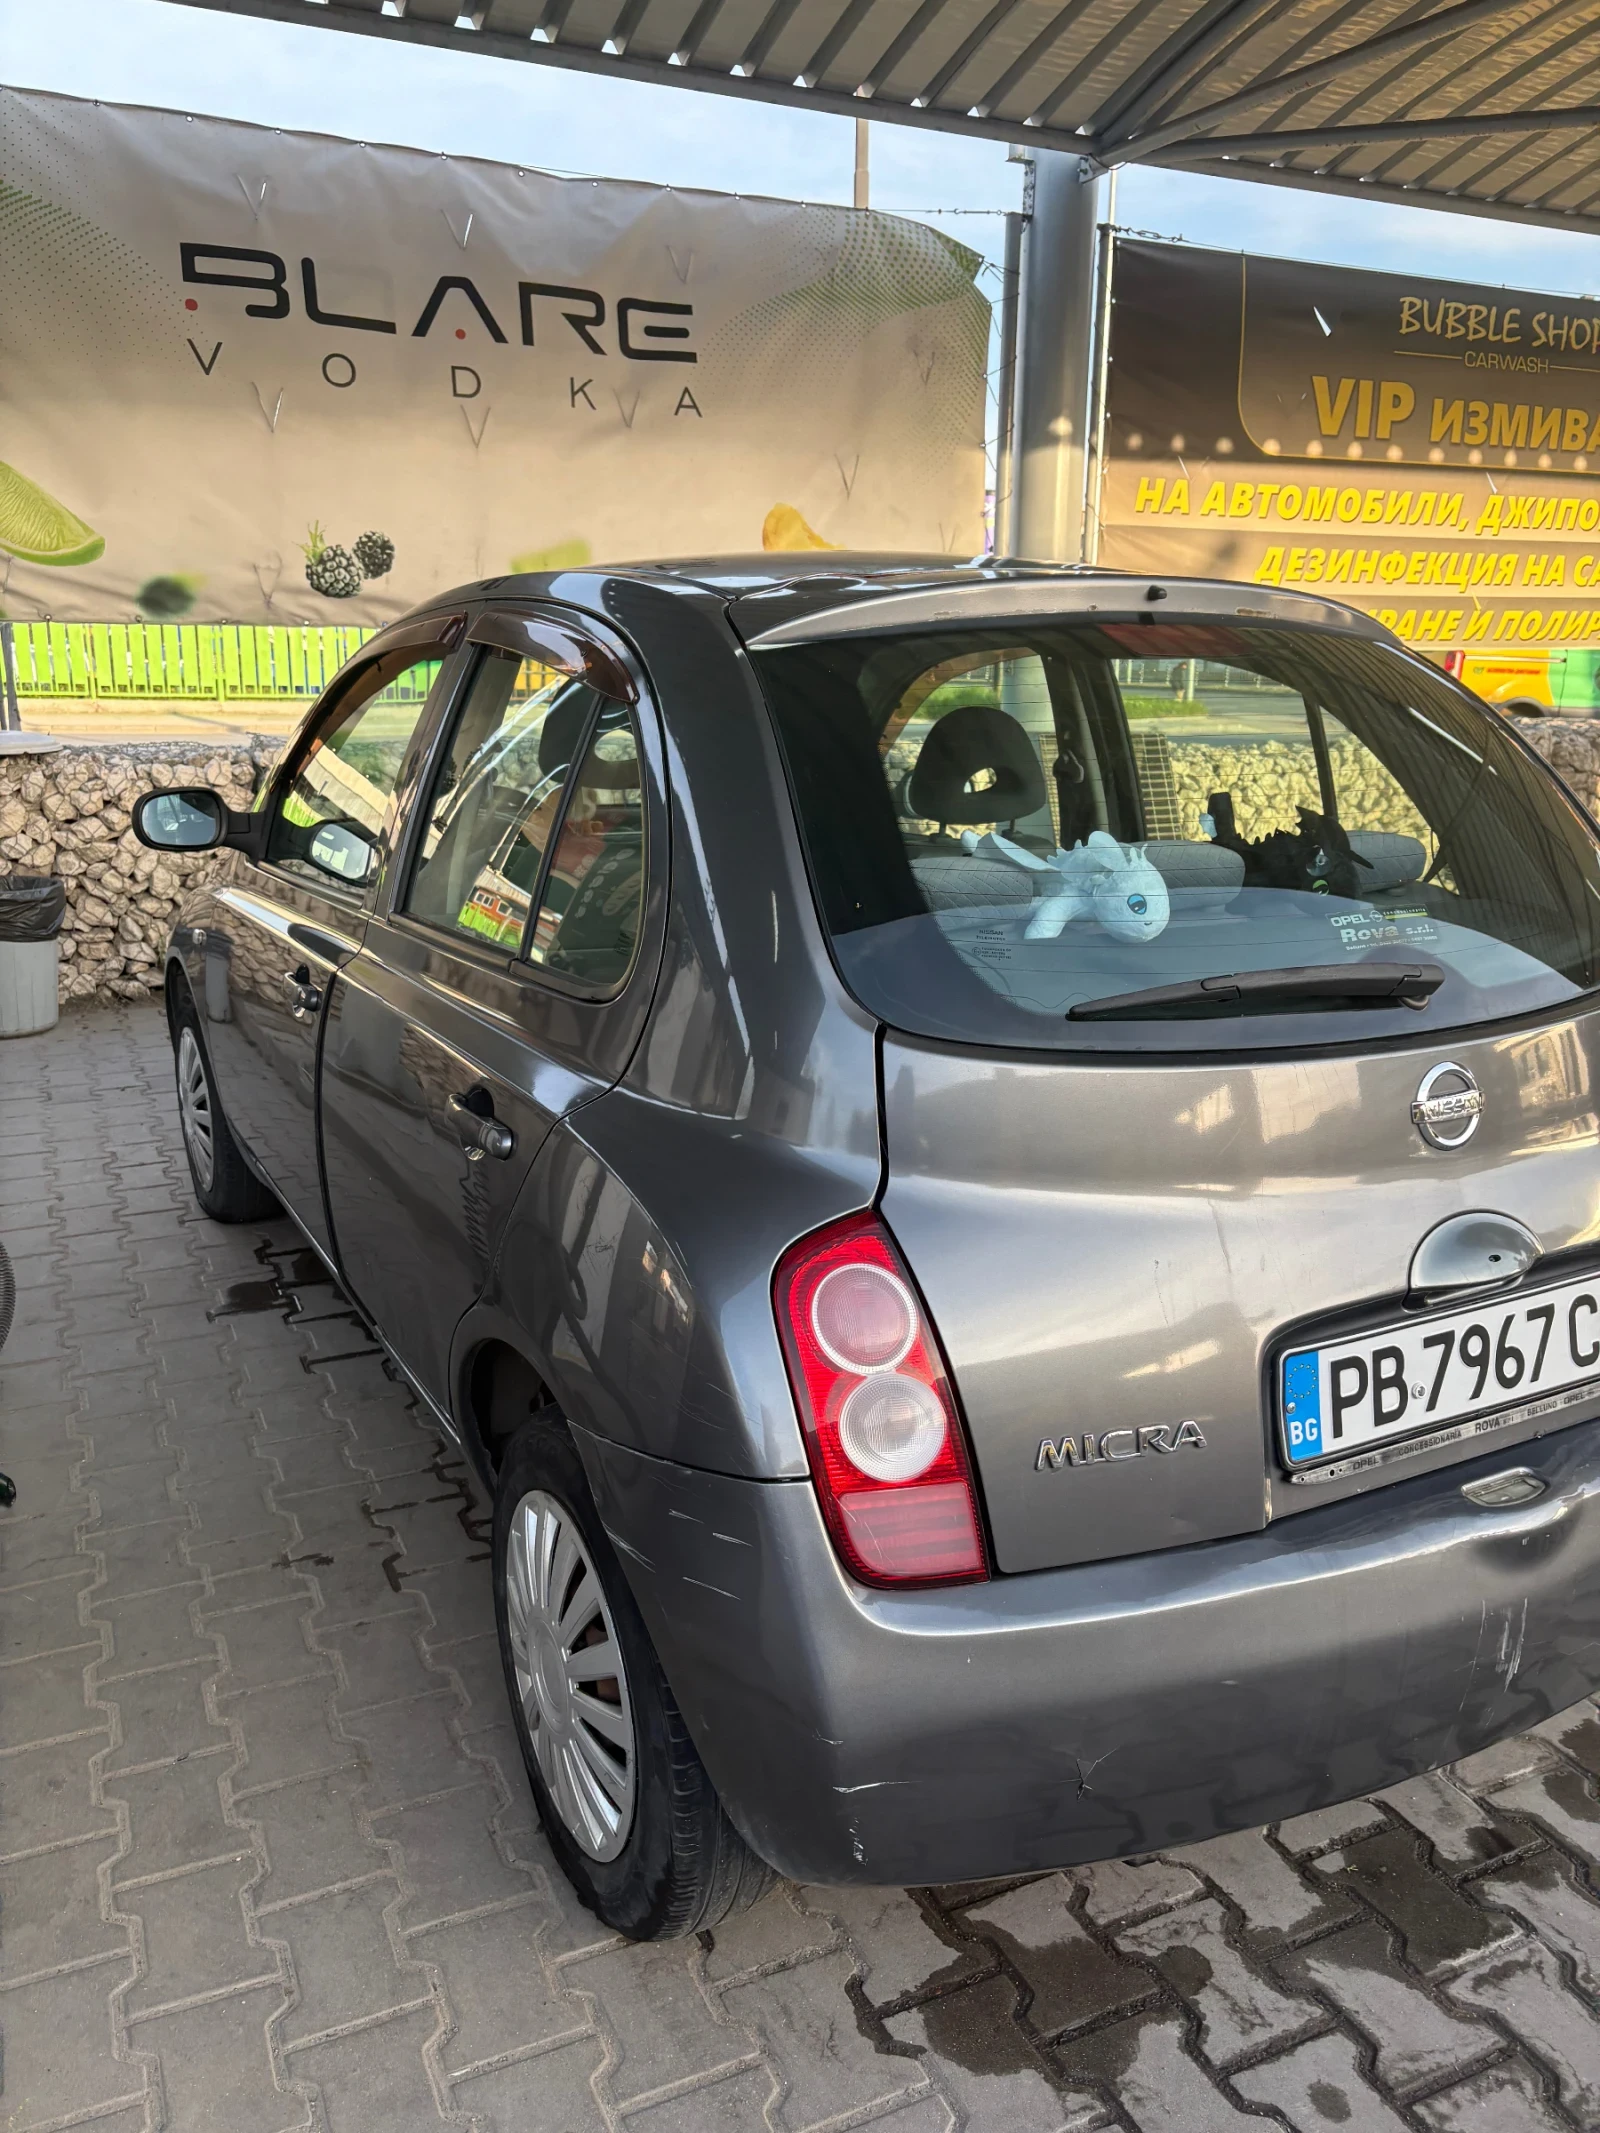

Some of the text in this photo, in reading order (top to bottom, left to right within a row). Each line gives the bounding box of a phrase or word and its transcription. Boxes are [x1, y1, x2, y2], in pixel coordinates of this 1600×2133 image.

[180, 242, 698, 364] BLARE
[1399, 296, 1521, 343] BUBBLE
[187, 338, 703, 418] VODKA
[1464, 351, 1549, 374] CARWASH
[1311, 375, 1416, 440] VIP
[1134, 477, 1600, 536] НА АВТОМОБИЛИ, ДЖИПО
[1254, 546, 1519, 593] ДЕЗИНФЕКЦИЯ
[1522, 554, 1566, 586] НА
[1368, 609, 1464, 641] РАНЕ
[1492, 610, 1600, 641] ПОЛИР
[1330, 914, 1371, 927] OPEL
[1340, 925, 1399, 943] Rova
[1329, 1345, 1409, 1439] PB
[1422, 1303, 1556, 1413] 7967
[1035, 1420, 1208, 1471] MICRA
[1289, 1418, 1318, 1446] BG
[1352, 1455, 1380, 1470] OPEL
[1475, 1416, 1501, 1433] ROVA
[1527, 1401, 1558, 1416] BELLUNO
[1563, 1392, 1585, 1405] OPEL
